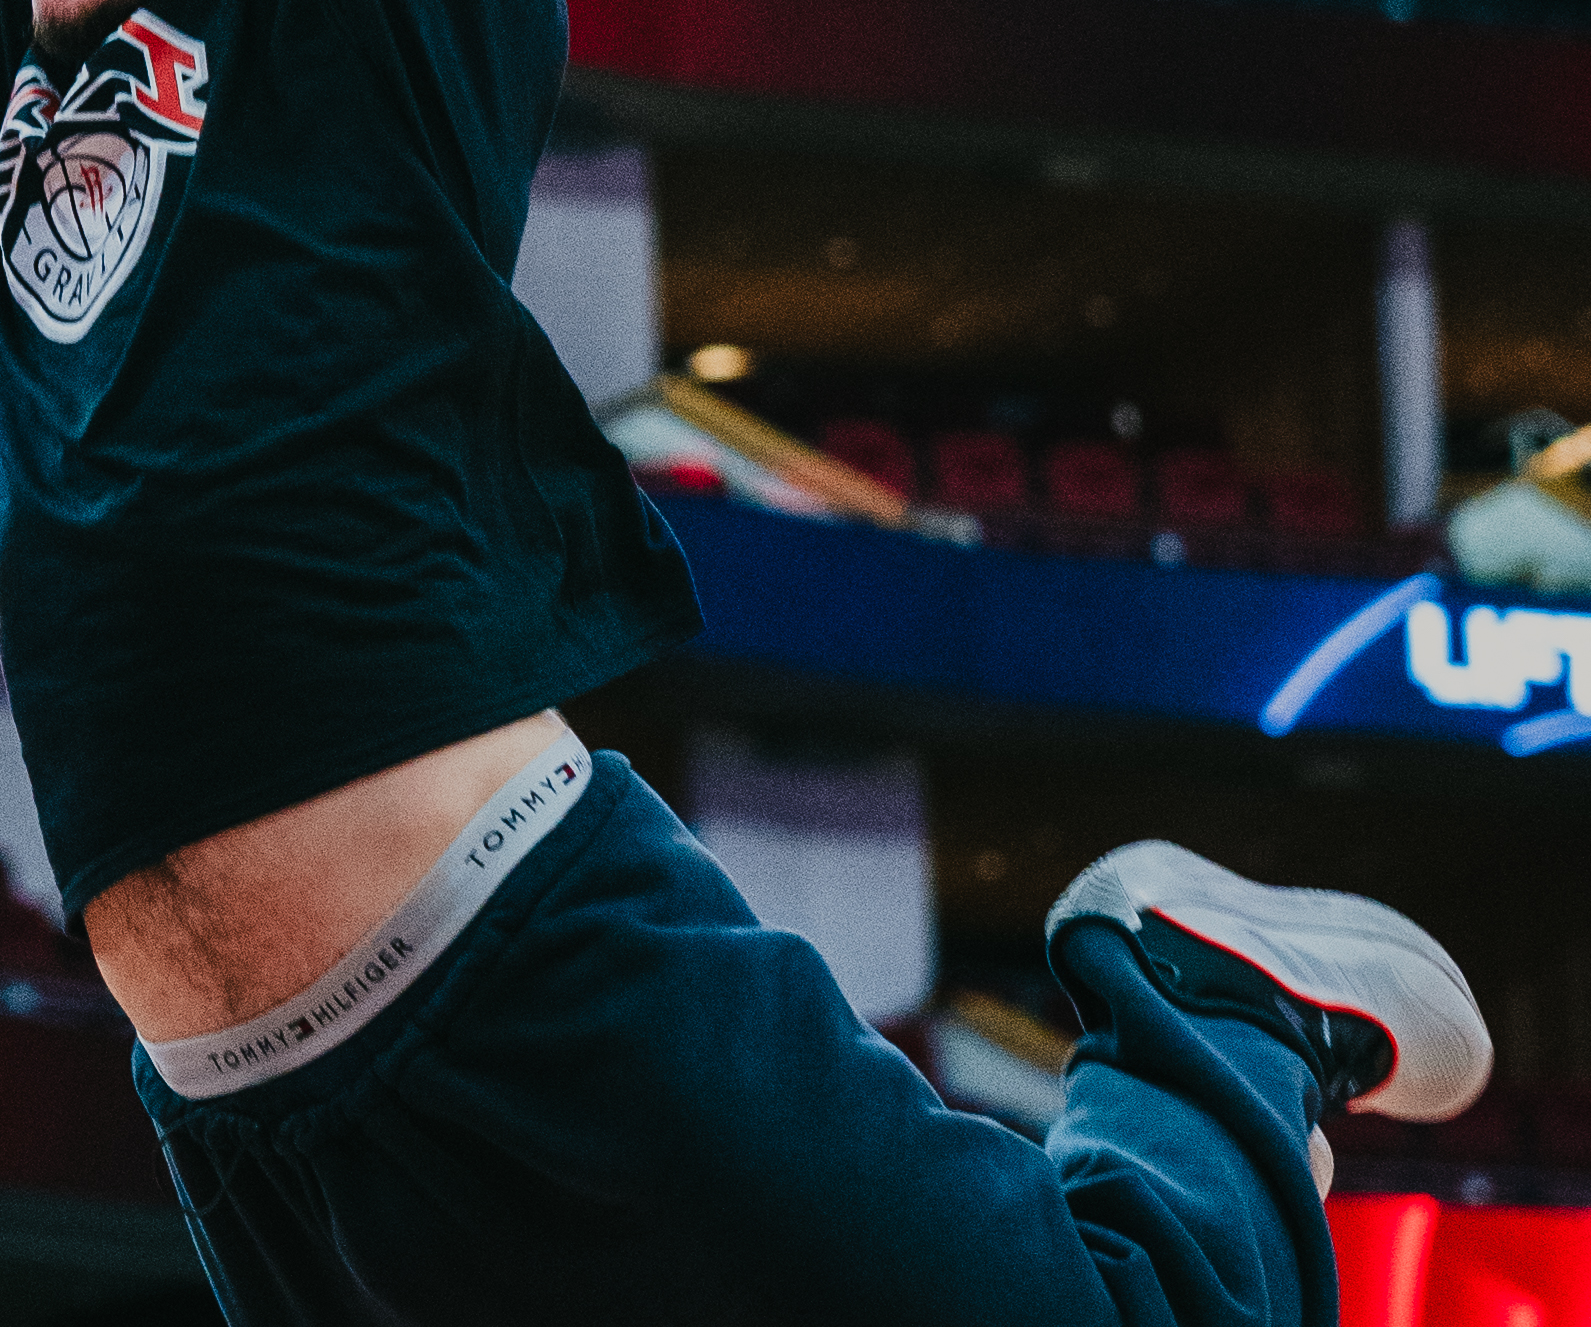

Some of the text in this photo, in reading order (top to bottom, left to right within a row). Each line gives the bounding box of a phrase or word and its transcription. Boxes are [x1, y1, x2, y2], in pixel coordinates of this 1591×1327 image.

[464, 776, 557, 869] TOMMY
[208, 937, 413, 1073] TOMMY HILFIGER
